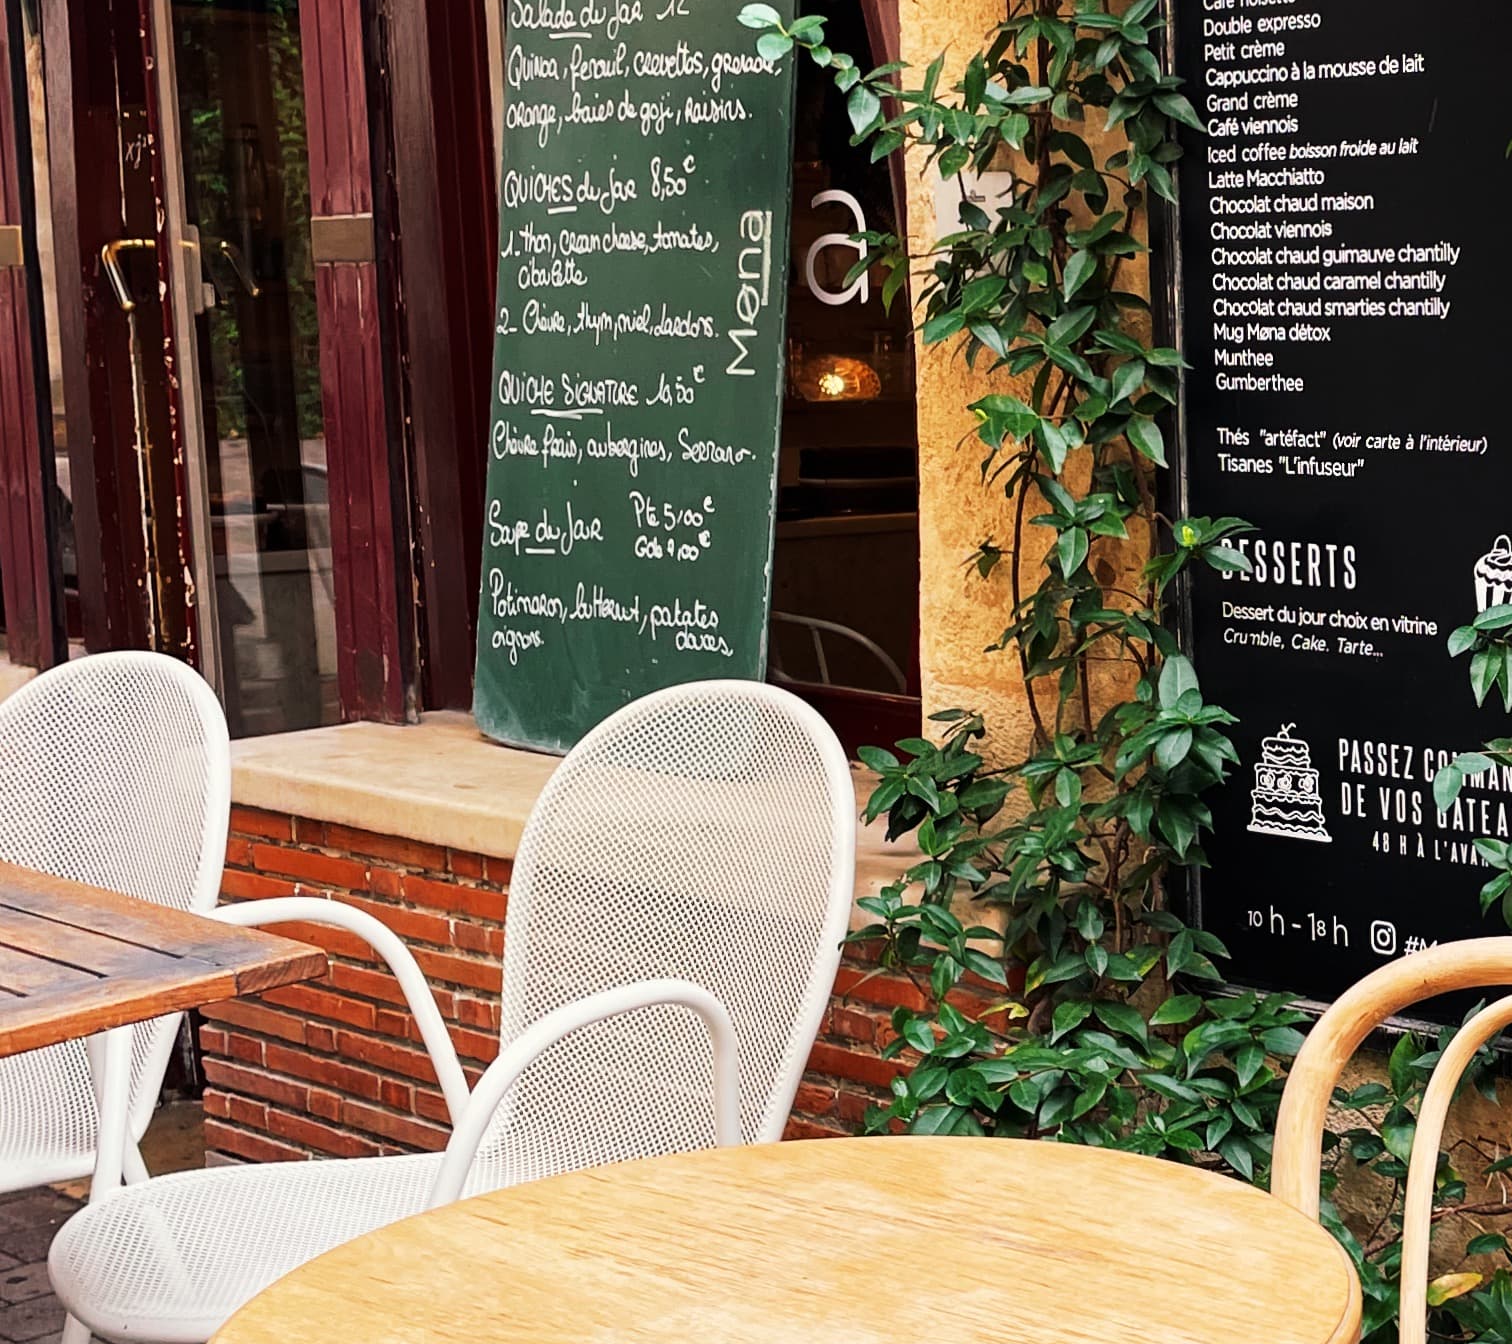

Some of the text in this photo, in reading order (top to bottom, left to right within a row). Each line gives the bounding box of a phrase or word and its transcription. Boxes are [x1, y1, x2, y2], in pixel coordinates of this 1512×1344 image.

[1202, 12, 1321, 37] Double expresso
[1203, 38, 1285, 62] Petit crème
[1204, 52, 1425, 89] Cappuccino à la mousse de lait
[1205, 90, 1299, 113] Grand crème
[1206, 113, 1299, 137] Café viennois
[1206, 141, 1287, 164] Iced coffee
[1207, 166, 1325, 189] Latte Macchiatto
[1208, 190, 1374, 215] Chocolat chaud maison
[1209, 218, 1333, 241] Chocolat viennois
[1210, 239, 1461, 267] Chocolat chaud guimauve chantilly
[1211, 269, 1446, 293] Chocolat chaud caramel chantilly
[1212, 296, 1451, 319] Chocolat chaud smarties chantilly
[1212, 321, 1244, 344] Mug
[1287, 321, 1331, 341] détox
[1213, 347, 1274, 367] Munthee
[1214, 371, 1304, 392] Gumberthee
[1215, 426, 1250, 446] Thés
[1331, 431, 1362, 450] (voir
[1364, 433, 1401, 450] carte
[1404, 432, 1414, 450] à
[1216, 452, 1274, 474] Tisanes
[1221, 600, 1438, 636] Dessert du jour choix en vitrine
[1337, 737, 1414, 780] PASSEZ
[1340, 781, 1422, 825] DE VOS
